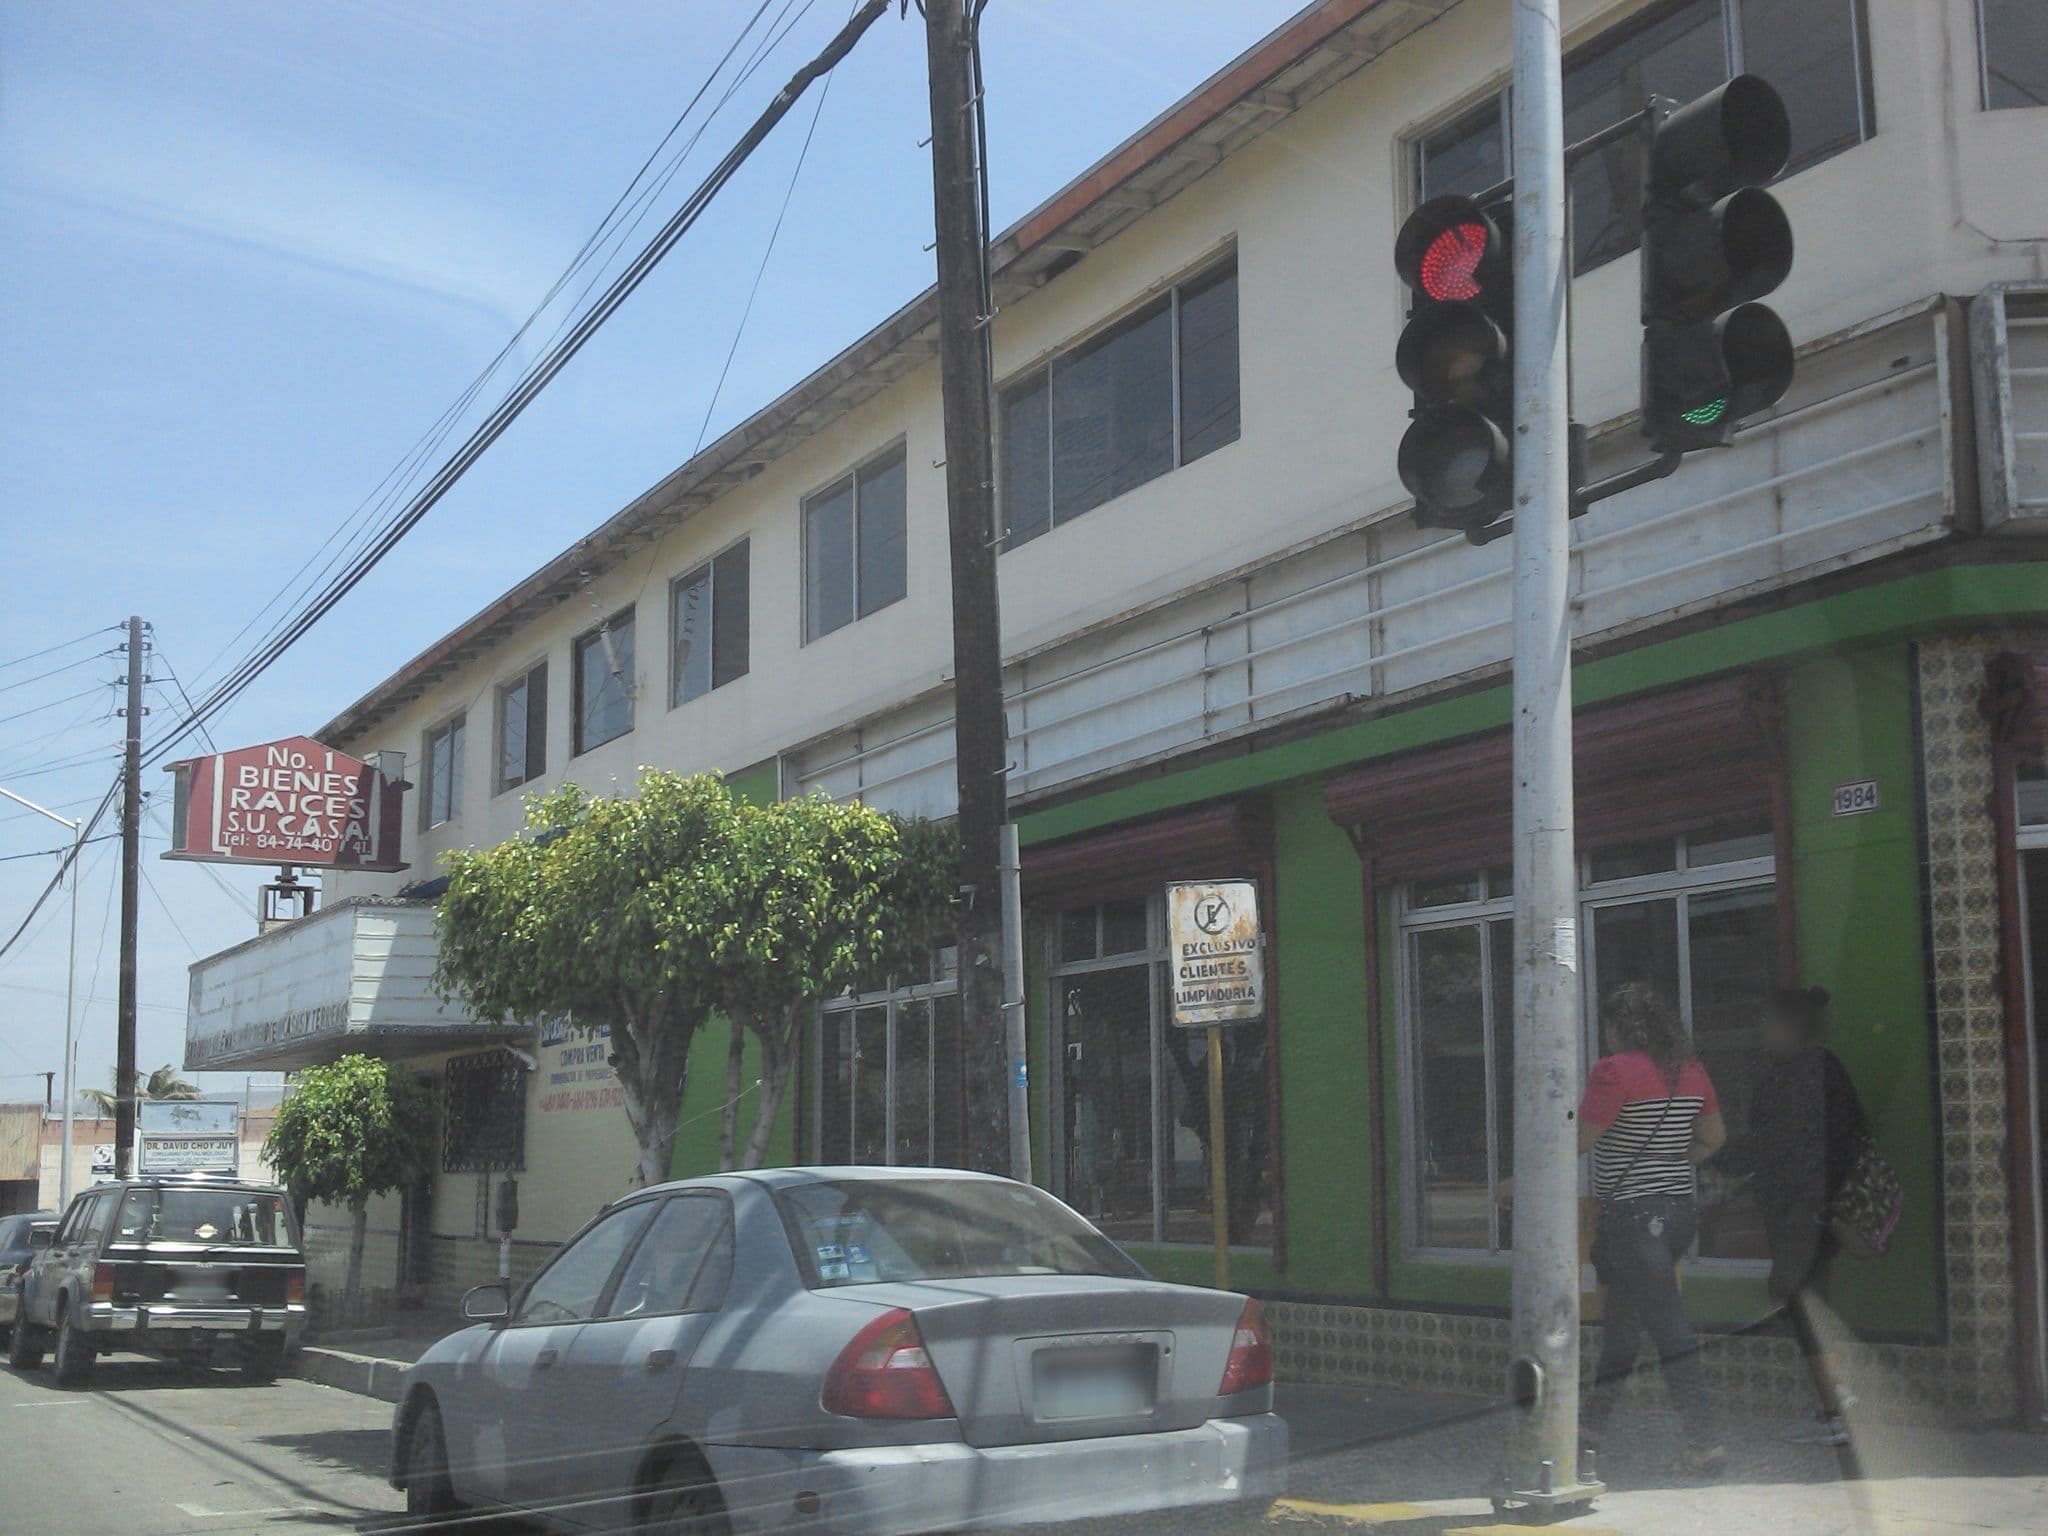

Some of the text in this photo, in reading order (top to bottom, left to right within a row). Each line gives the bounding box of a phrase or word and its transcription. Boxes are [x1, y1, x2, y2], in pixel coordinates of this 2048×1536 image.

[267, 746, 334, 772] No. 1
[239, 765, 359, 797] BIENES
[230, 787, 366, 819] RAICES
[1837, 785, 1875, 809] 1984
[222, 831, 250, 847] Tel:
[256, 834, 333, 853] 84-74-40
[1182, 940, 1256, 957] EXCLUSIVO
[1180, 961, 1247, 979] CLIENTES
[146, 1142, 160, 1151] DR.
[162, 1142, 190, 1151] DAVID
[191, 1141, 215, 1150] CHOY
